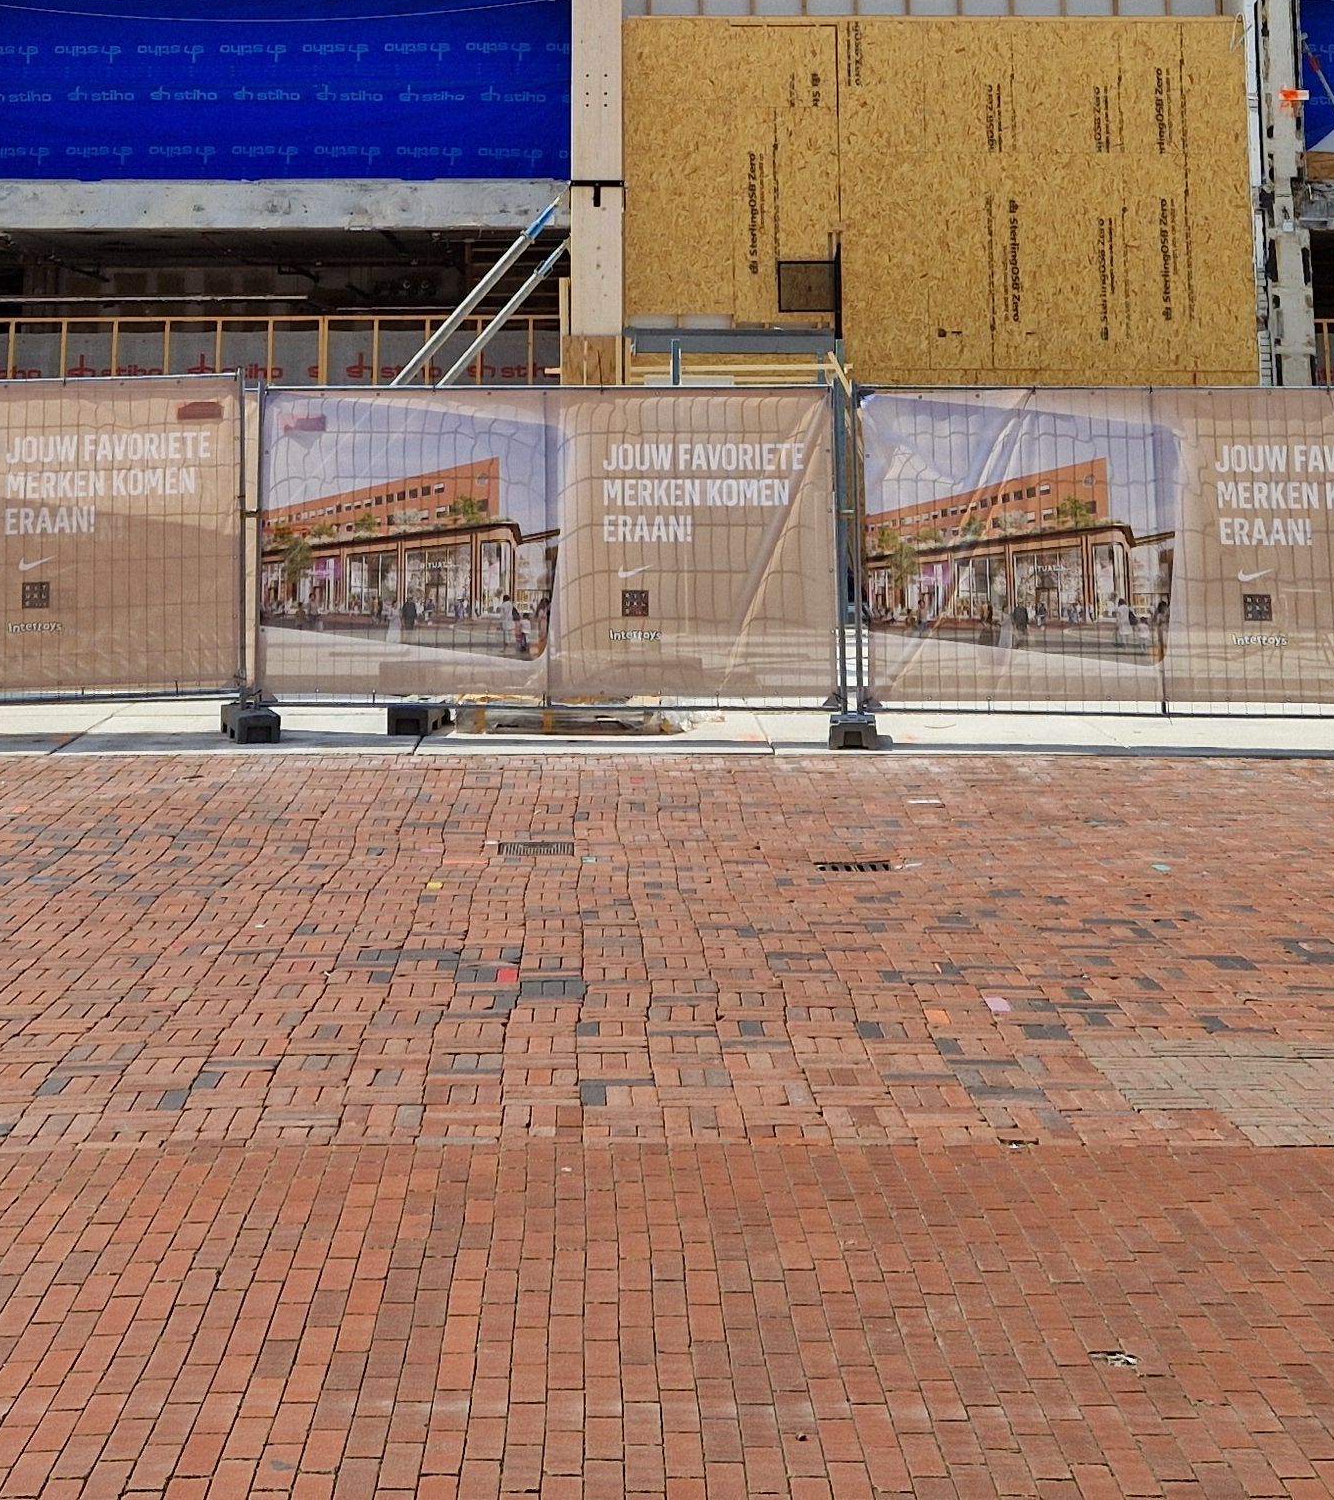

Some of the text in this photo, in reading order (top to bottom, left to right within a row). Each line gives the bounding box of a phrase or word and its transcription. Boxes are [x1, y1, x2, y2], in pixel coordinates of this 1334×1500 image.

[747, 153, 757, 181] Zero
[1158, 198, 1168, 226] Zero
[1012, 294, 1021, 322] Zero
[6, 431, 211, 464] JOUW FAVORIETE
[603, 443, 804, 471] JOUW FAVORIETE
[1215, 444, 1287, 473] JOUW
[6, 467, 196, 499] MERKEN KOMEN
[603, 478, 789, 506] MERKEN KOMEN
[1218, 480, 1319, 509] MERKEN
[4, 505, 95, 535] ERAAN!
[603, 515, 692, 542] ERAAN!
[1219, 517, 1313, 546] ERAAN!
[7, 621, 62, 634] Intertoys
[609, 628, 662, 642] Intertoys
[1232, 633, 1288, 646] Intertoys
